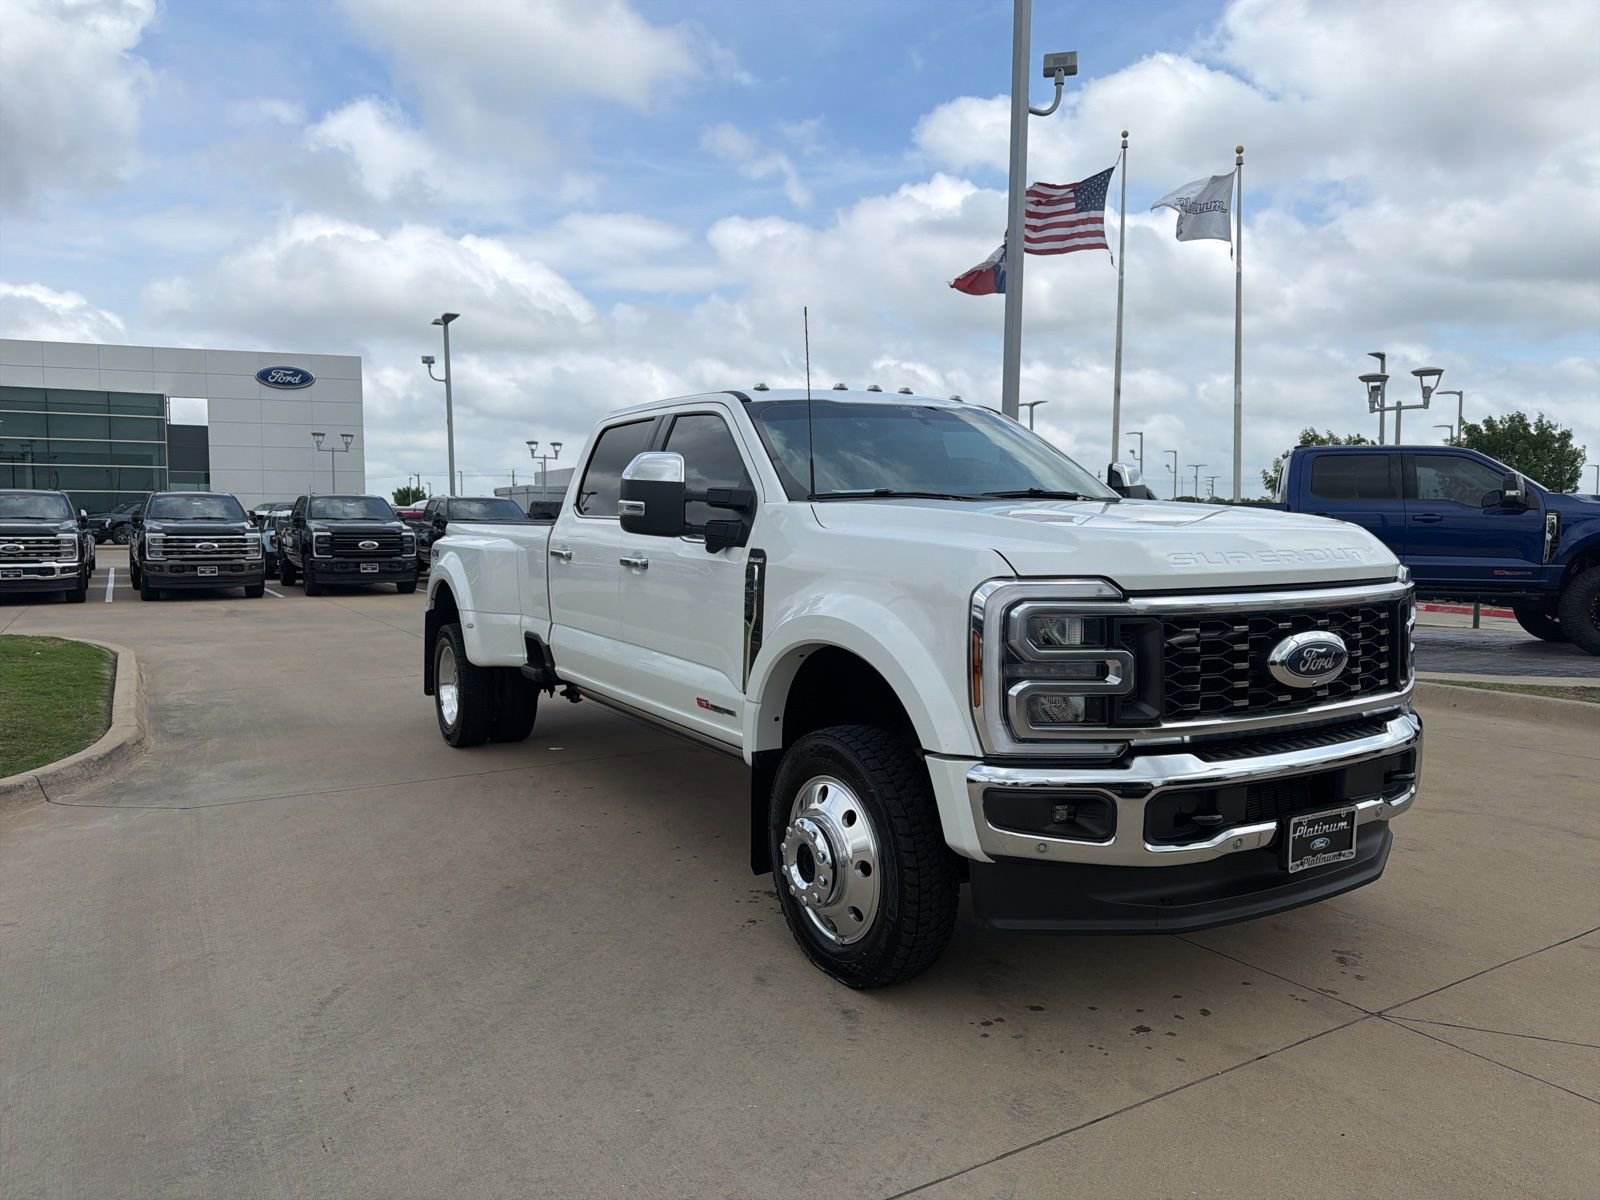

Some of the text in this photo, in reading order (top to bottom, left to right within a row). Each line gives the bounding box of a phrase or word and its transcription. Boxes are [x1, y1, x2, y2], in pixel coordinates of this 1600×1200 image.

[268, 369, 302, 384] Ford
[1167, 549, 1301, 567] SUPER
[1299, 647, 1335, 672] Ford
[1291, 821, 1350, 839] Platinum
[1302, 853, 1342, 868] Platinum
